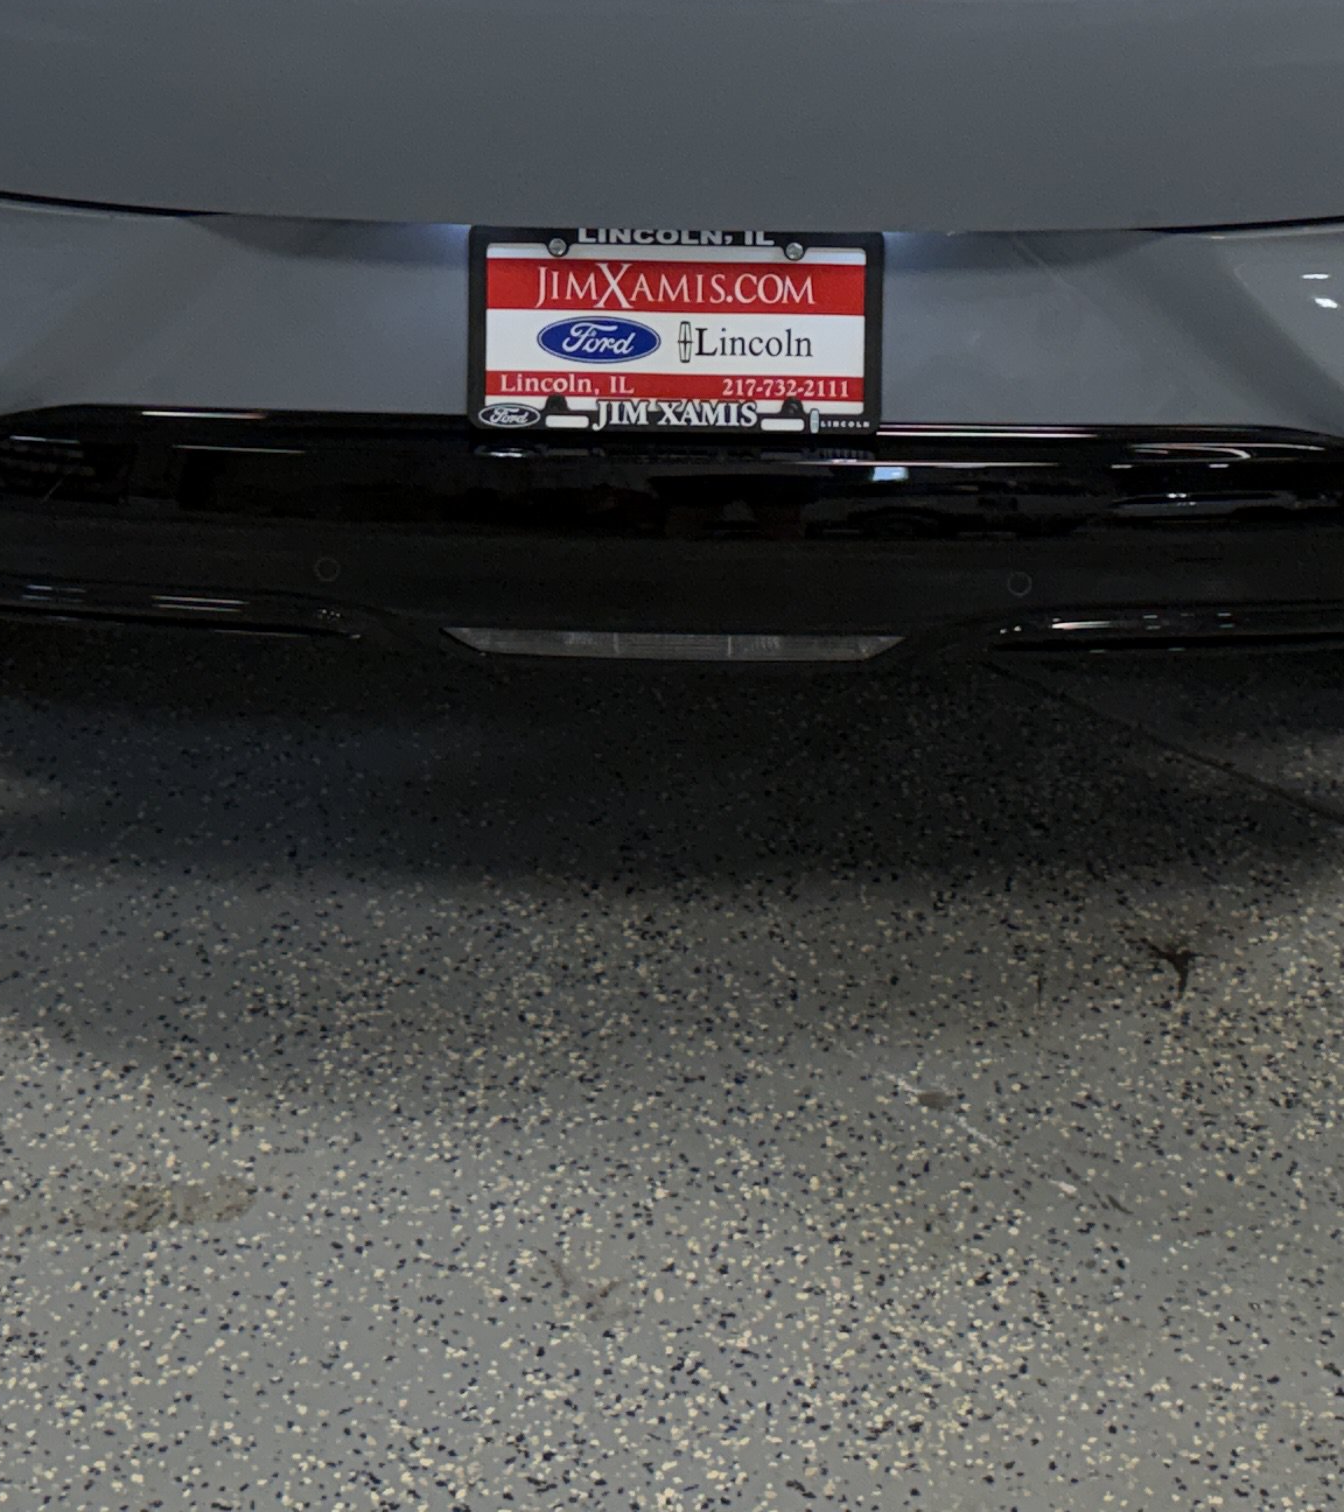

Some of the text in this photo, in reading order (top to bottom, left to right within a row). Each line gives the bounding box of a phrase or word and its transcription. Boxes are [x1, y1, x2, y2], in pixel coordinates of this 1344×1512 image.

[577, 227, 776, 247] LINCOLN, IL
[533, 262, 816, 309] JIMXAMIS.COM
[561, 324, 637, 355] Ford
[694, 327, 814, 358] Lincoln
[500, 374, 635, 395] Lincoln, IL
[722, 378, 849, 398] 217-732-2111
[489, 407, 529, 424] Ford
[592, 400, 757, 431] JIM XAMIS
[820, 420, 871, 428] LINCOLN
